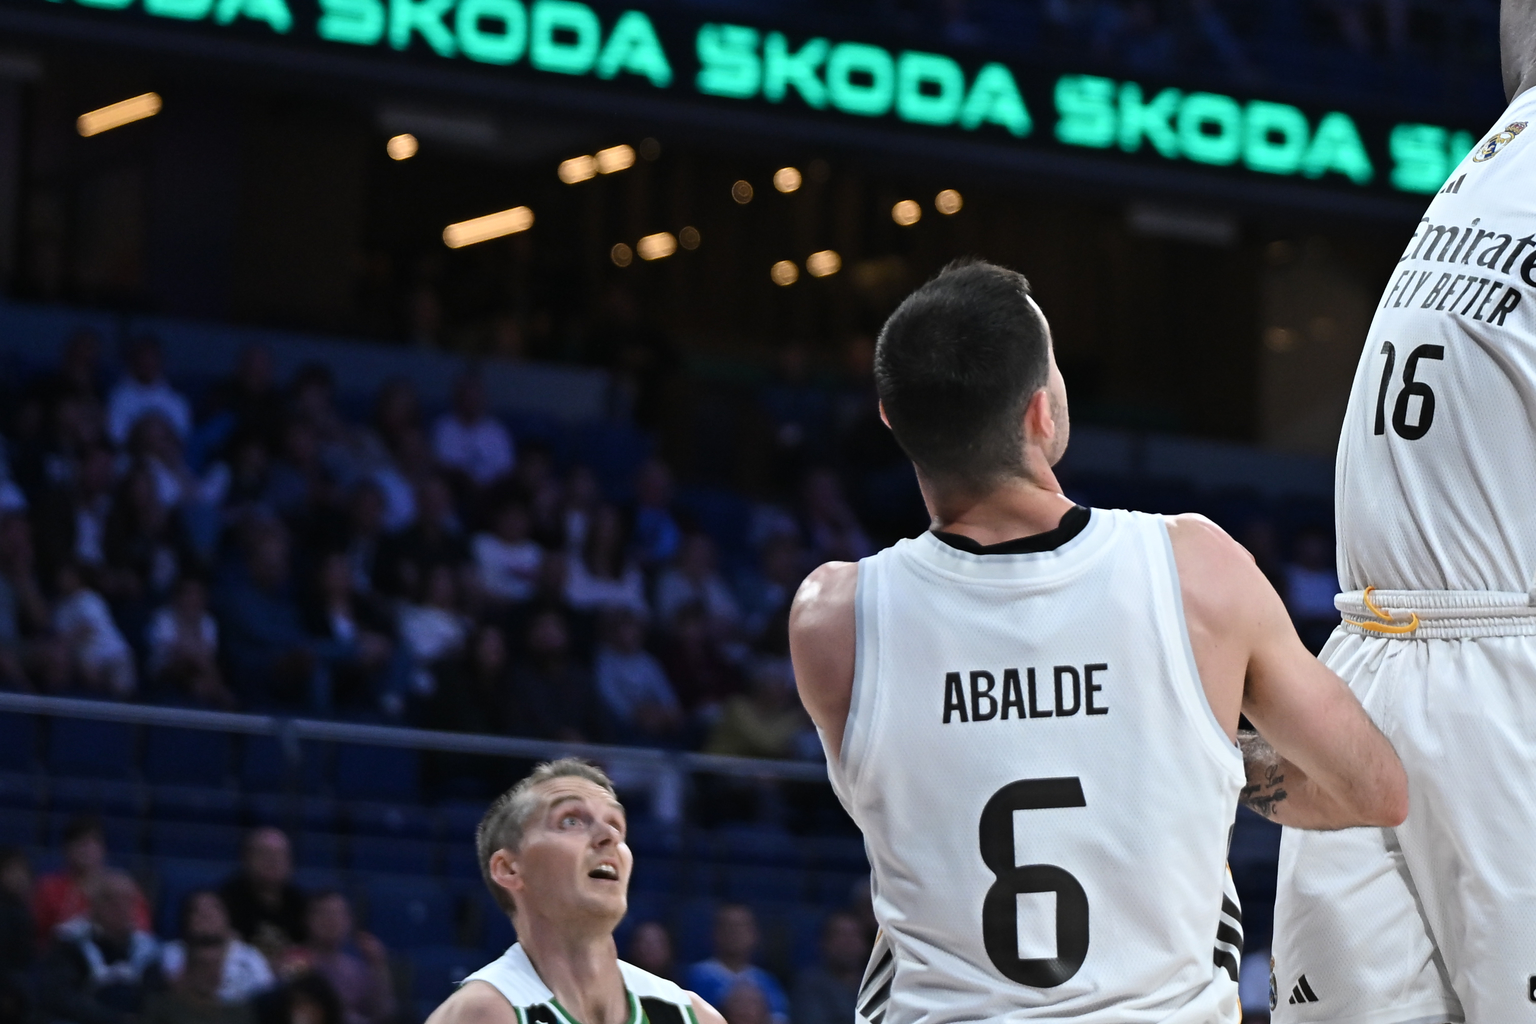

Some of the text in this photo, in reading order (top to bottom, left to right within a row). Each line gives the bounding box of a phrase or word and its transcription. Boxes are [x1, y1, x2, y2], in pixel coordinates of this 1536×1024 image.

[1383, 270, 1522, 327] FLY BETTER
[1373, 339, 1446, 442] 16
[942, 662, 1110, 725] ABALDE
[977, 776, 1090, 988] 6
